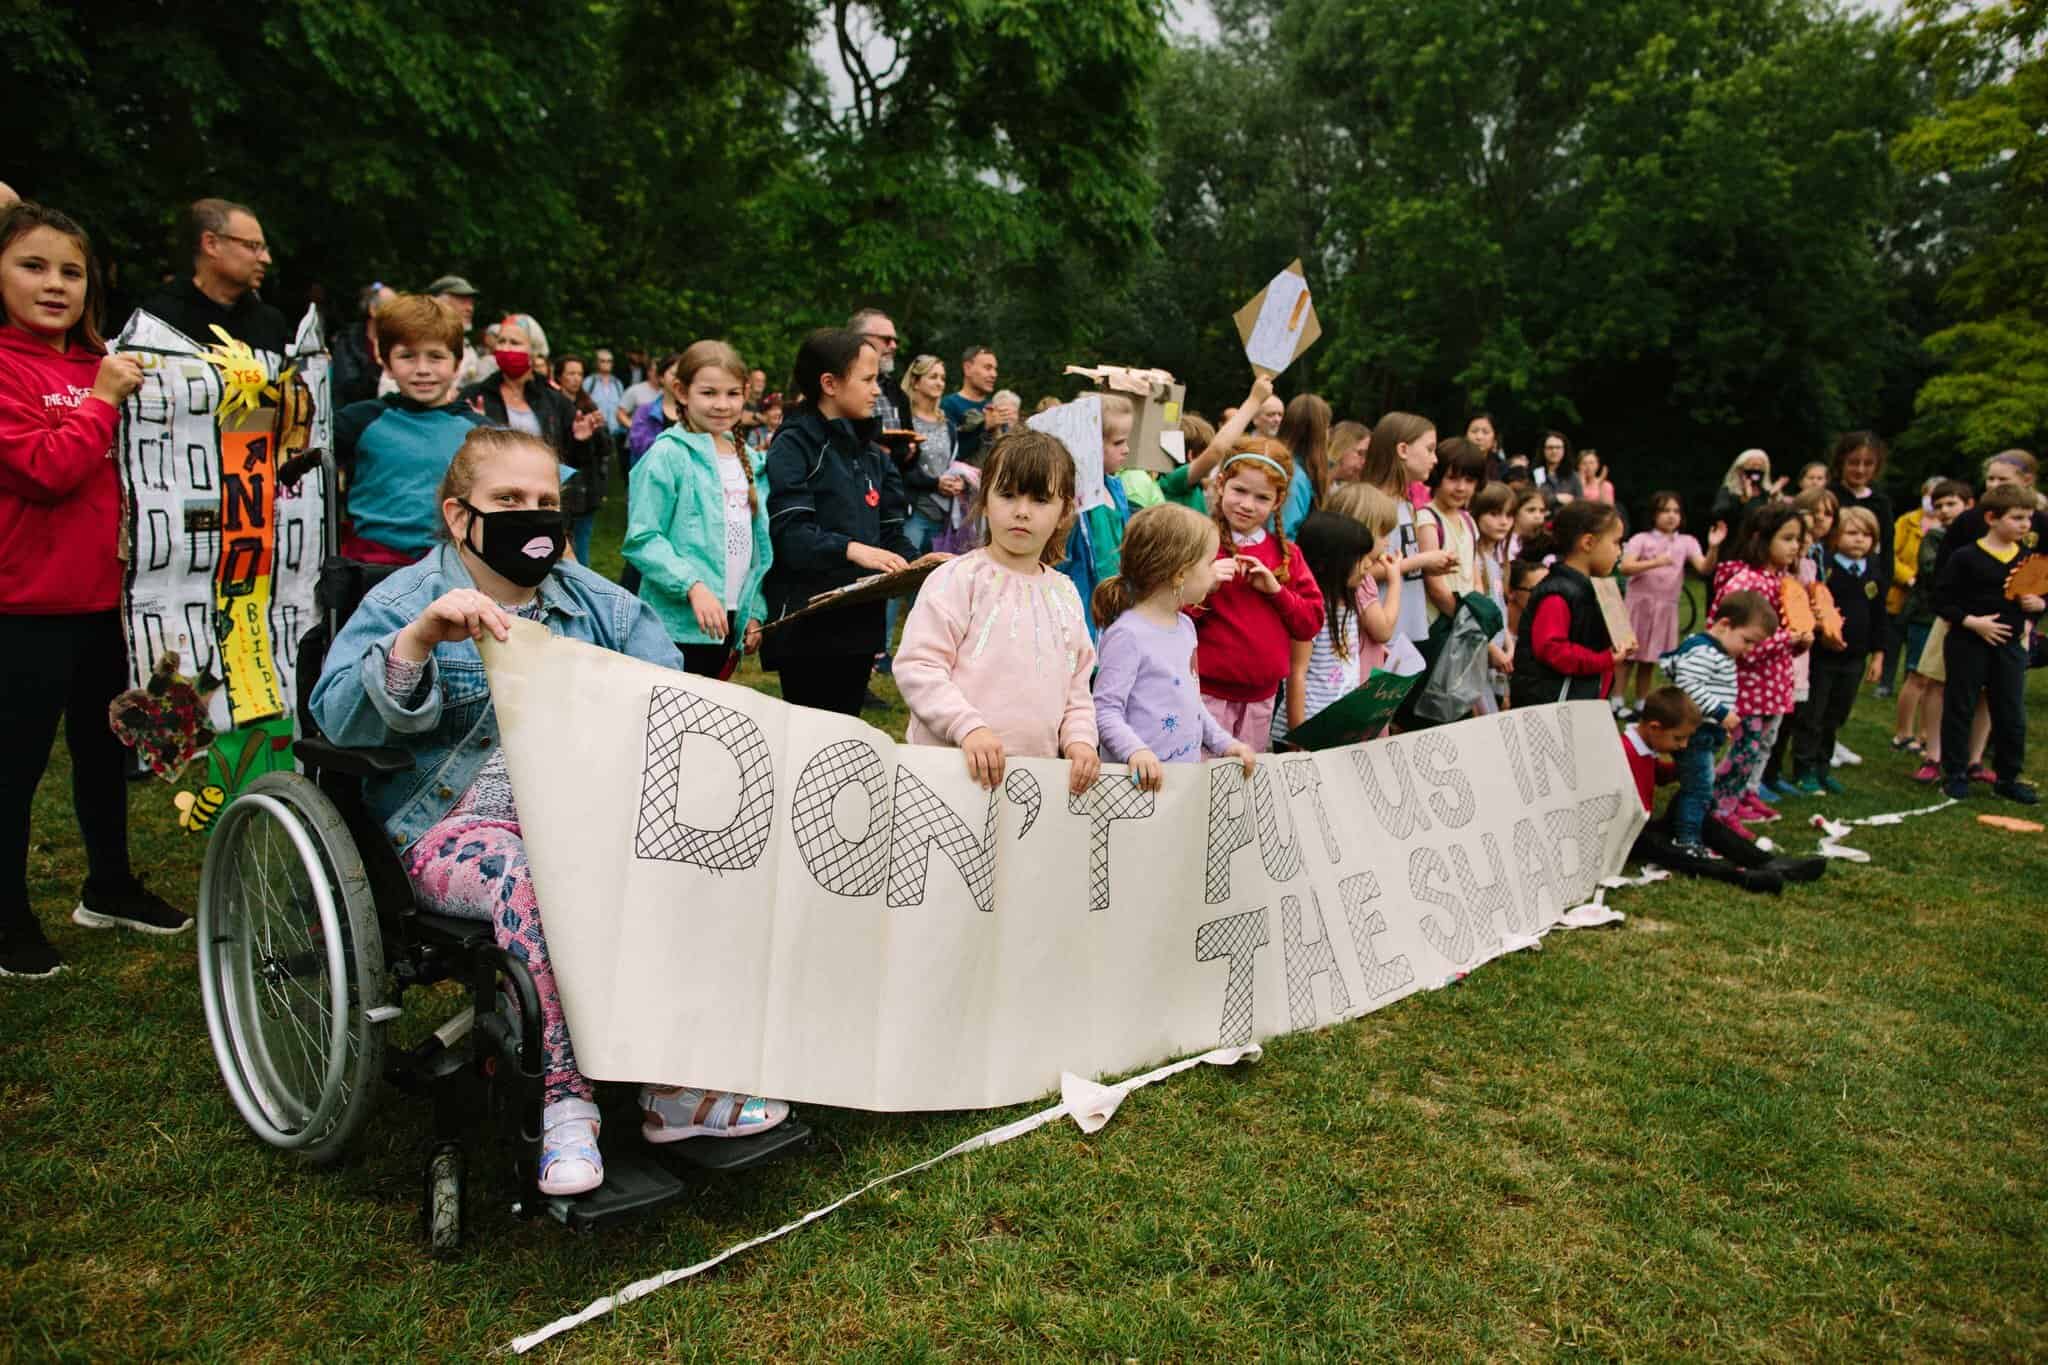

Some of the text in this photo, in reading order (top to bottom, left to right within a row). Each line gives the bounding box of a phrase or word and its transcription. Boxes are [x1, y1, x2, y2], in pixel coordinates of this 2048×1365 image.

[233, 369, 262, 385] YES
[221, 473, 265, 598] NO
[636, 686, 1577, 912] DON'T PUT US IN
[1195, 870, 1416, 1048] THE
